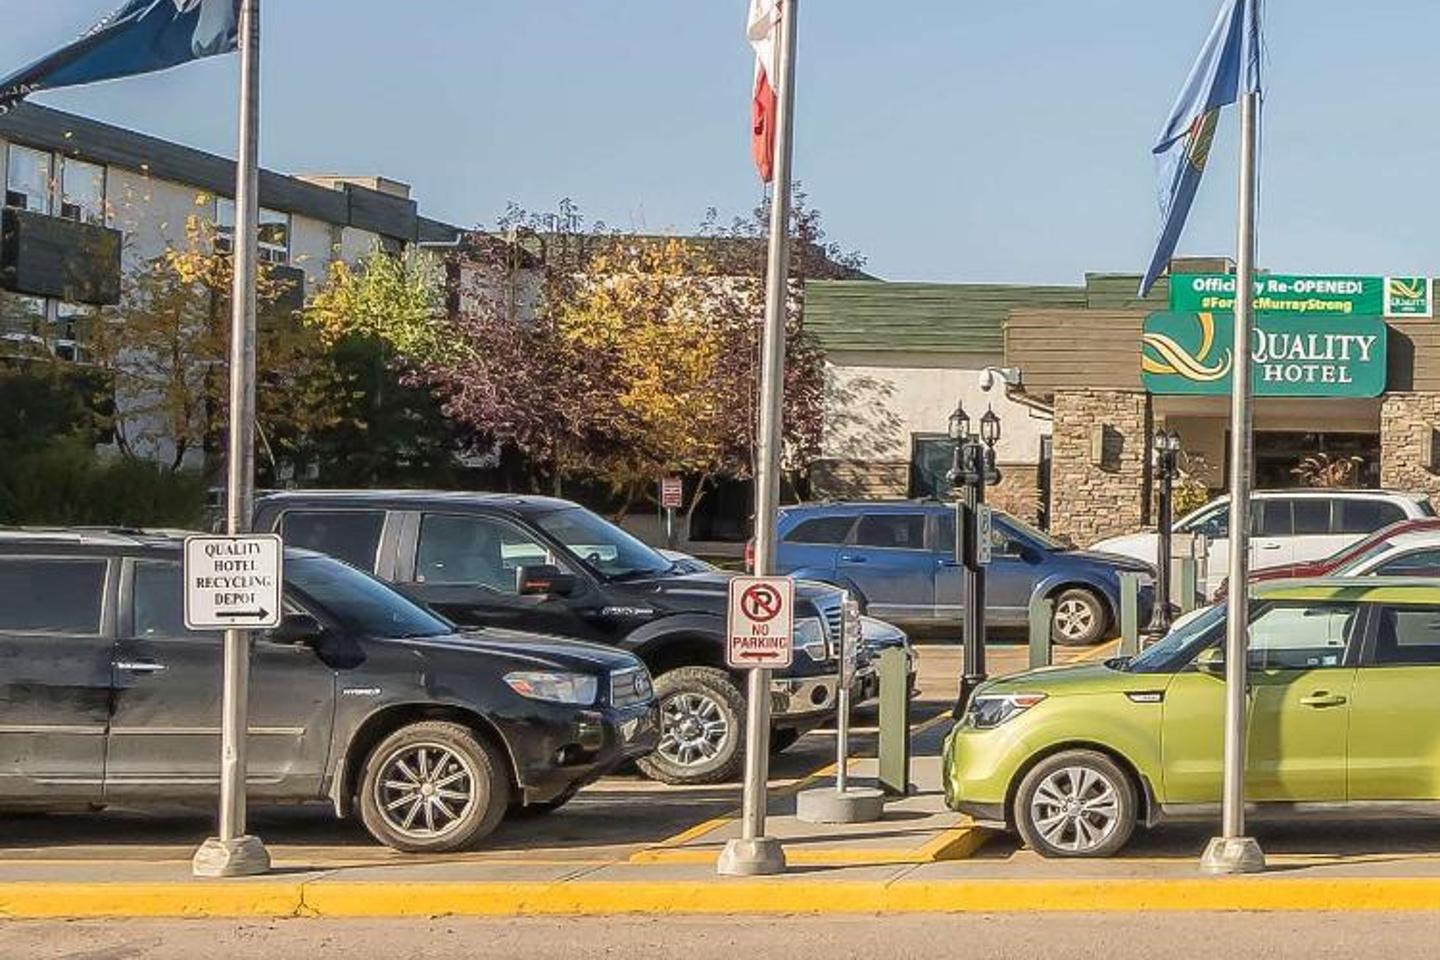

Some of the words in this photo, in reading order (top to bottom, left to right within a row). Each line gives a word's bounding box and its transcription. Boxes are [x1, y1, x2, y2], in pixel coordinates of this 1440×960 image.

[1192, 278, 1264, 296] Officiy
[1267, 280, 1363, 295] Re-OPENED!
[1263, 364, 1352, 383] HOTEL
[204, 543, 261, 557] QUALITY
[214, 560, 256, 571] HOTEL
[196, 576, 271, 589] RECYCLING
[214, 592, 256, 605] DEPOT
[751, 623, 769, 636] NO
[732, 637, 787, 649] PARKING
